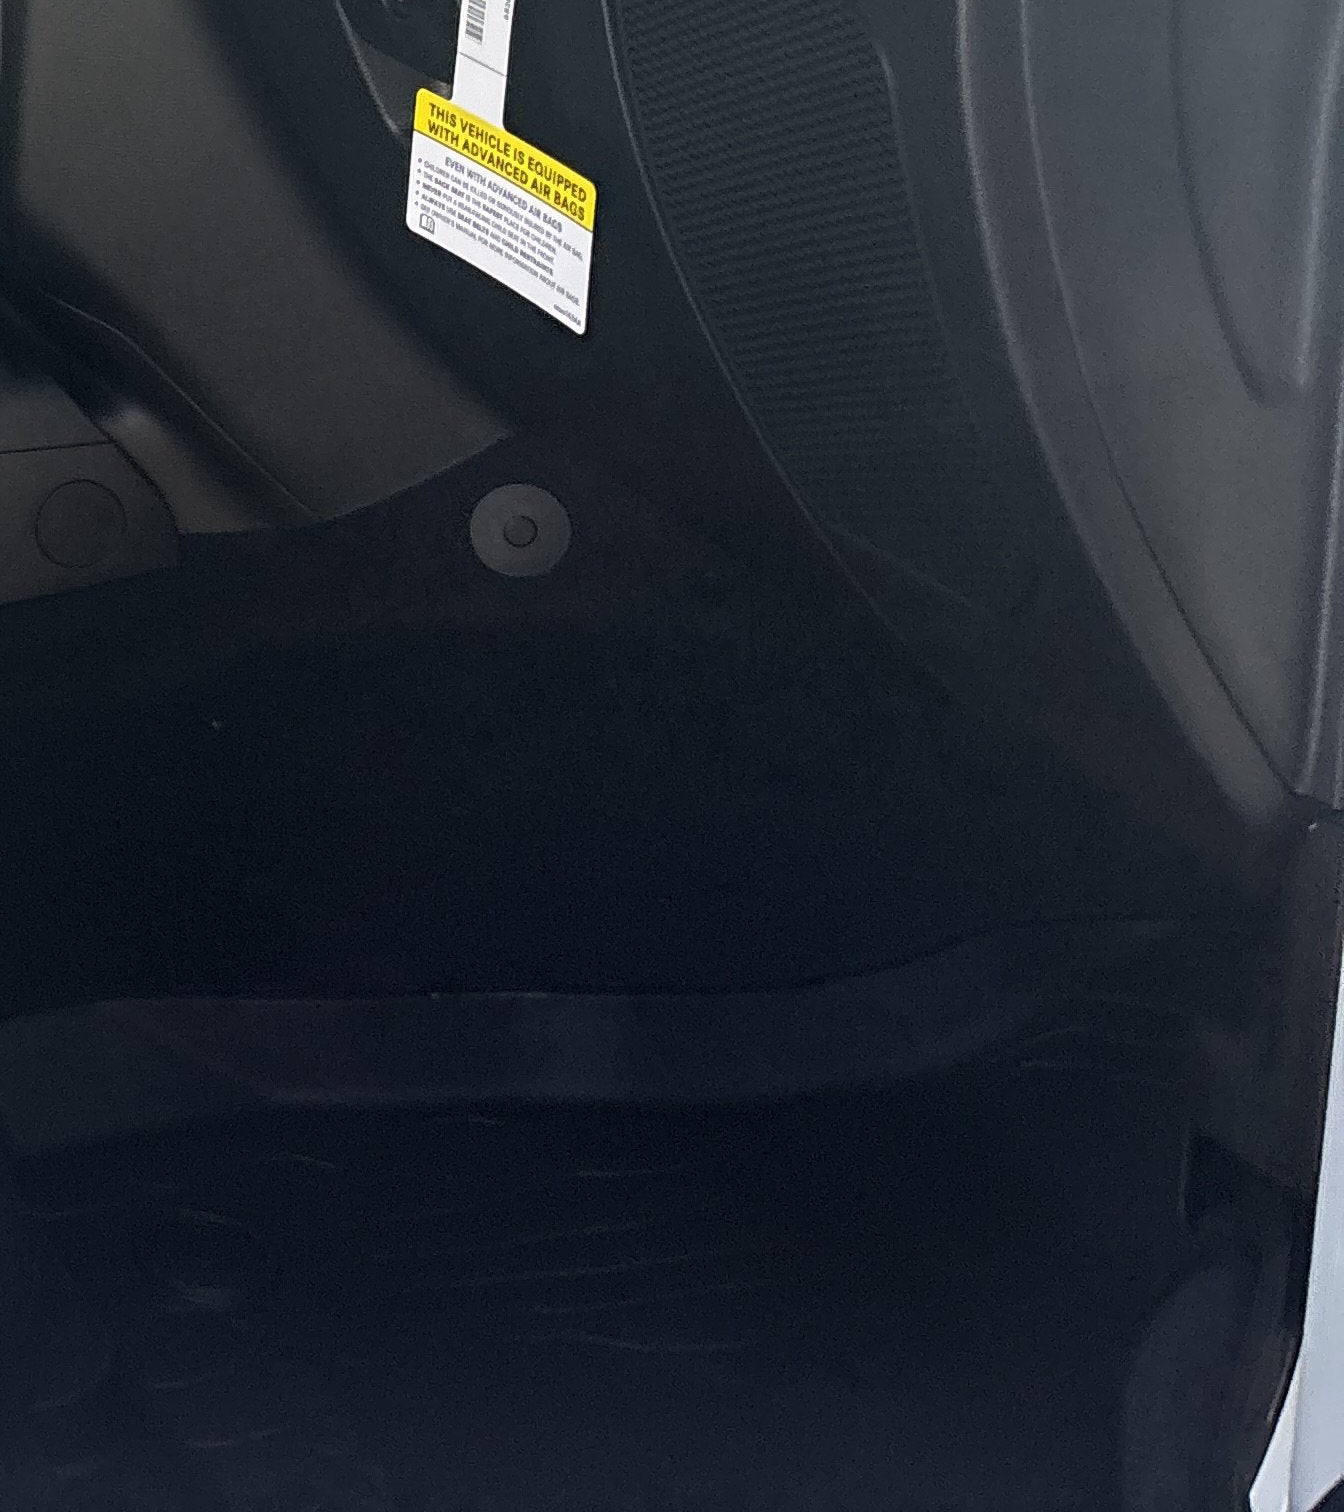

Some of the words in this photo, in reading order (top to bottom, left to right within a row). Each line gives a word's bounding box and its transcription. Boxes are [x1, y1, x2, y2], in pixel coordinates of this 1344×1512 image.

[426, 118, 459, 148] WITH
[461, 136, 528, 186] ADVANCED
[530, 176, 551, 200] AIR
[553, 189, 585, 222] BAGS
[428, 101, 457, 129] THIS
[459, 117, 511, 158] VEHICLE
[512, 148, 525, 167] IS
[527, 155, 587, 204] EQUIPPED
[444, 155, 465, 176] EVEN
[466, 167, 486, 188] WITH
[486, 178, 528, 212] ADVANCED
[527, 202, 541, 220] AIR
